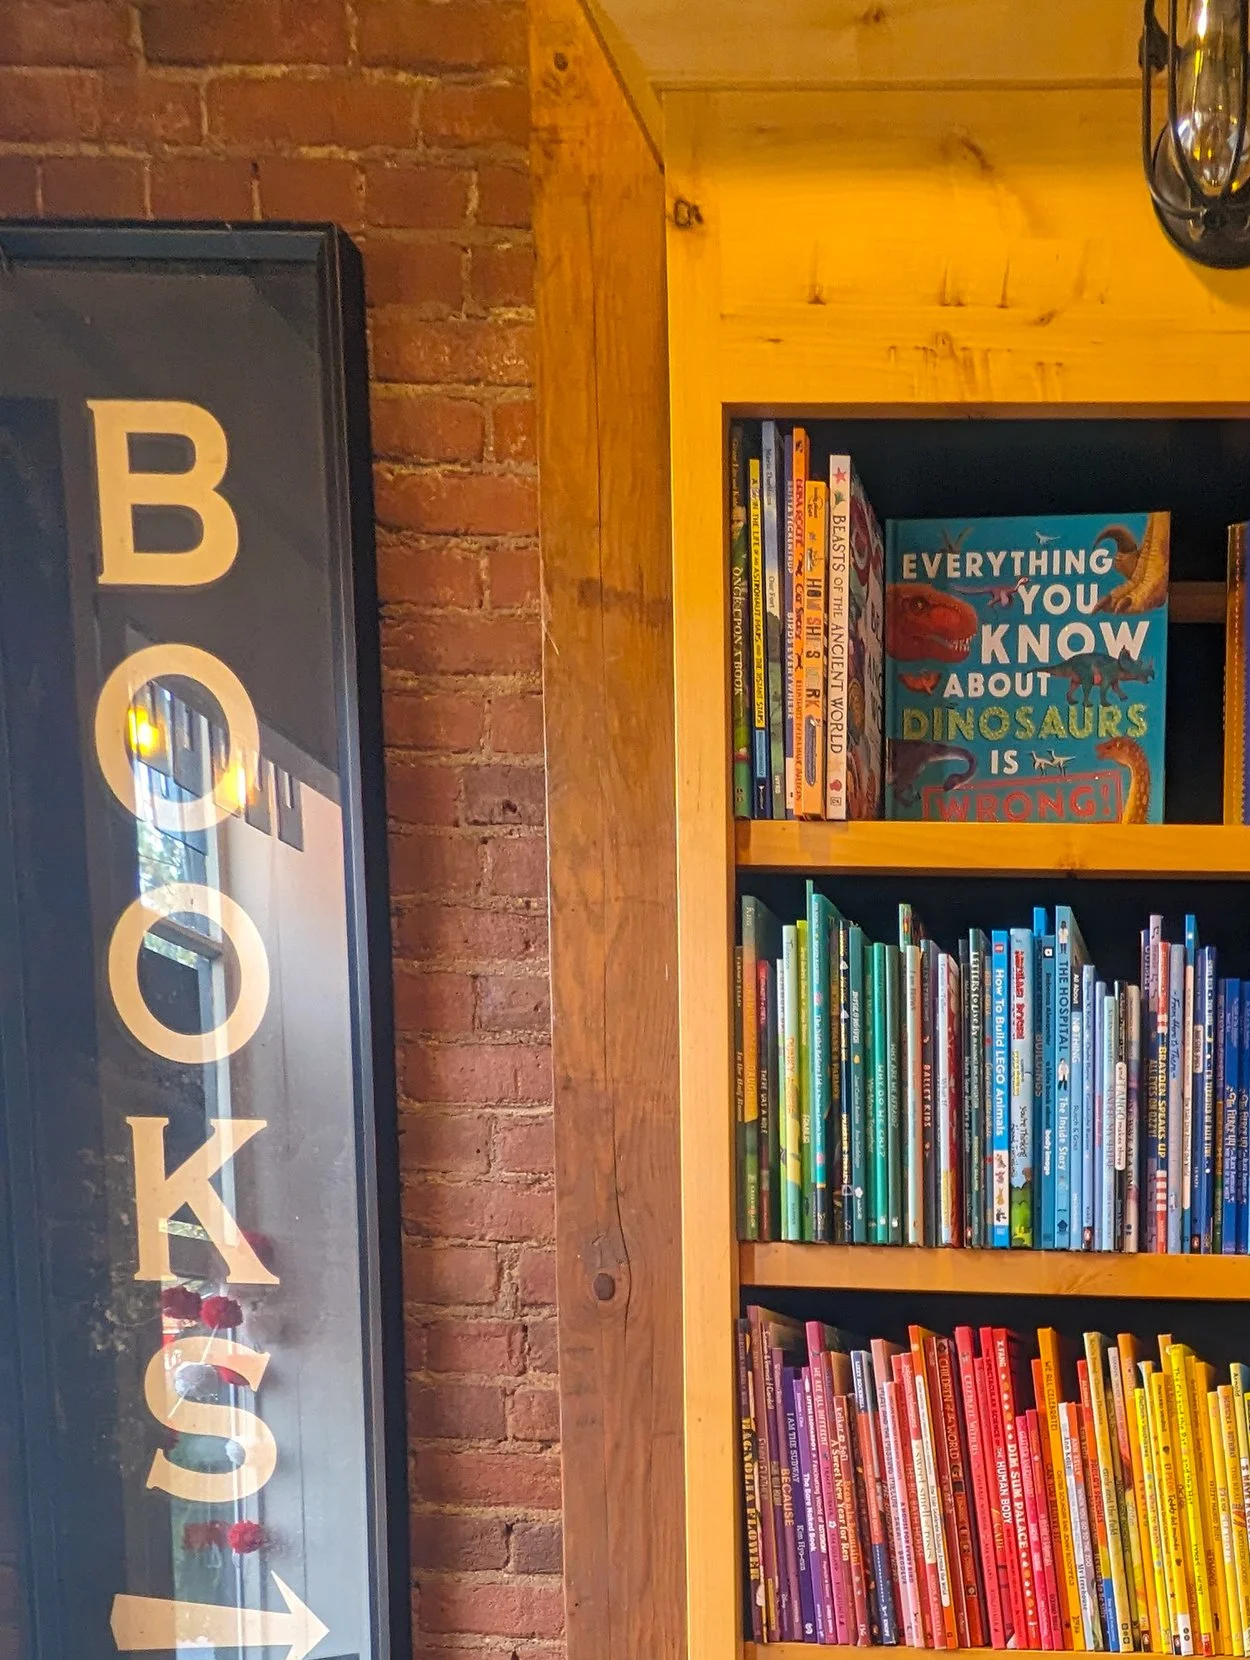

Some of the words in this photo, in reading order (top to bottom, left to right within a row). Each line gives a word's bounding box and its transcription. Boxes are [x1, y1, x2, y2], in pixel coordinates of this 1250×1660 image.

[833, 515, 846, 571] BEASTS
[903, 548, 1113, 580] EVERYTHING
[833, 578, 843, 593] OF
[1018, 584, 1098, 615] YOU
[833, 596, 843, 618] THE
[831, 623, 845, 689] ANCIENT
[981, 621, 1149, 663] KNOW
[943, 672, 1053, 698] ABOUT
[830, 698, 844, 754] WORLD
[902, 704, 1148, 743] DINOSAURS
[991, 750, 1018, 775] IS
[933, 781, 1116, 821] WRONG!
[86, 398, 280, 1502] BOOKS
[995, 969, 1006, 991] How
[1059, 961, 1069, 982] THE
[995, 994, 1006, 1012] To
[1059, 986, 1068, 1051] HOSPITAL
[995, 1017, 1006, 1048] Build
[995, 1051, 1006, 1084] LEGO
[1158, 1047, 1167, 1096] BRAYDEN
[995, 1088, 1006, 1136] Animals
[1058, 1097, 1067, 1113] The
[1158, 1101, 1167, 1139] SPEAKS
[1044, 1130, 1052, 1149] body
[1058, 1117, 1067, 1146] Inside
[1043, 1151, 1052, 1175] image
[1057, 1149, 1067, 1170] Story
[1157, 1144, 1167, 1158] UP
[1009, 1443, 1018, 1468] DIM
[997, 1461, 1008, 1495] HUMAN
[1010, 1471, 1022, 1499] SUM
[781, 1468, 793, 1526] BECAUSE
[1000, 1498, 1011, 1523] BODY
[1014, 1502, 1028, 1548] PALACE
